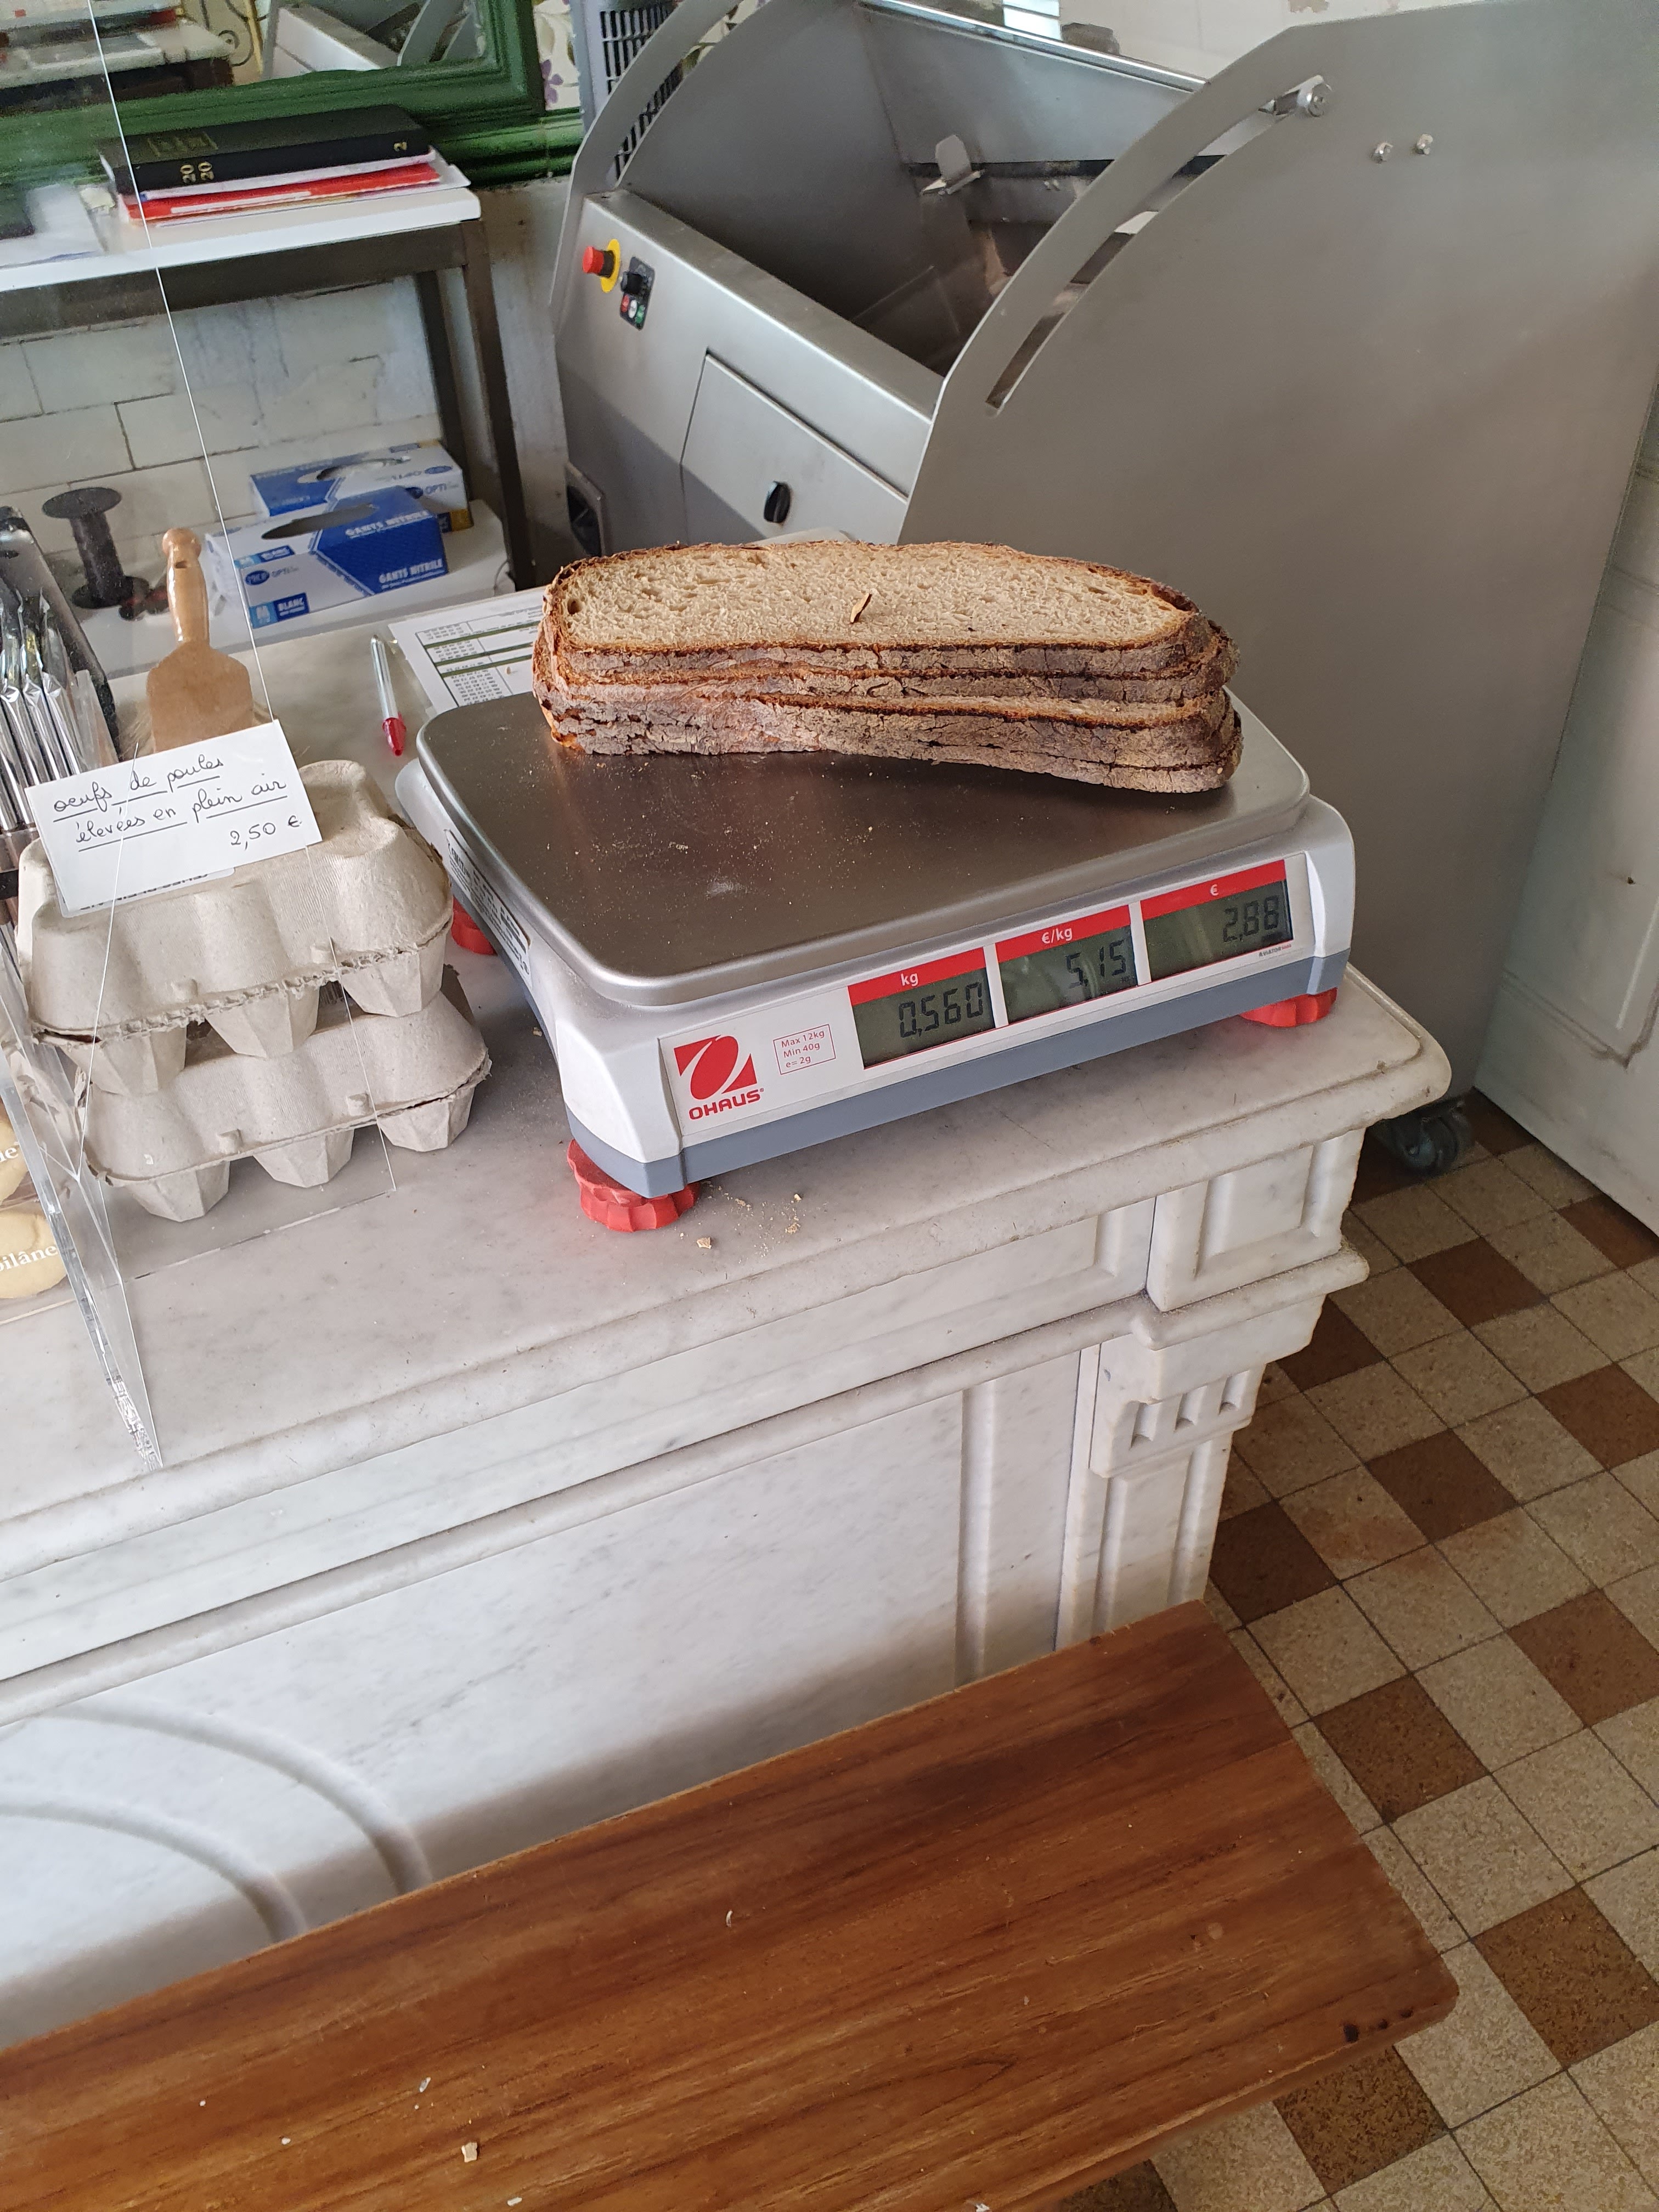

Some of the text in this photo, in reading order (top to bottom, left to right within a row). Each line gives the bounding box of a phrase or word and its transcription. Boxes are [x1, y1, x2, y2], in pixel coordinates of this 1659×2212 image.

[379, 567, 409, 583] GANTS
[409, 558, 443, 575] NITRILE
[130, 770, 158, 791] de
[167, 754, 224, 793] poules
[76, 772, 287, 843] élevées en plein air
[230, 814, 303, 850] 2,50 €
[1210, 884, 1219, 896] €
[1222, 895, 1280, 943] 2,88
[1042, 927, 1073, 944] €/kg
[901, 973, 919, 986] kg
[898, 981, 984, 1038] 0,560
[781, 1030, 825, 1048] Max 12kg
[783, 1042, 821, 1058] Min 40g
[799, 1055, 811, 1065] 2g
[689, 1088, 761, 1121] OHAUS
